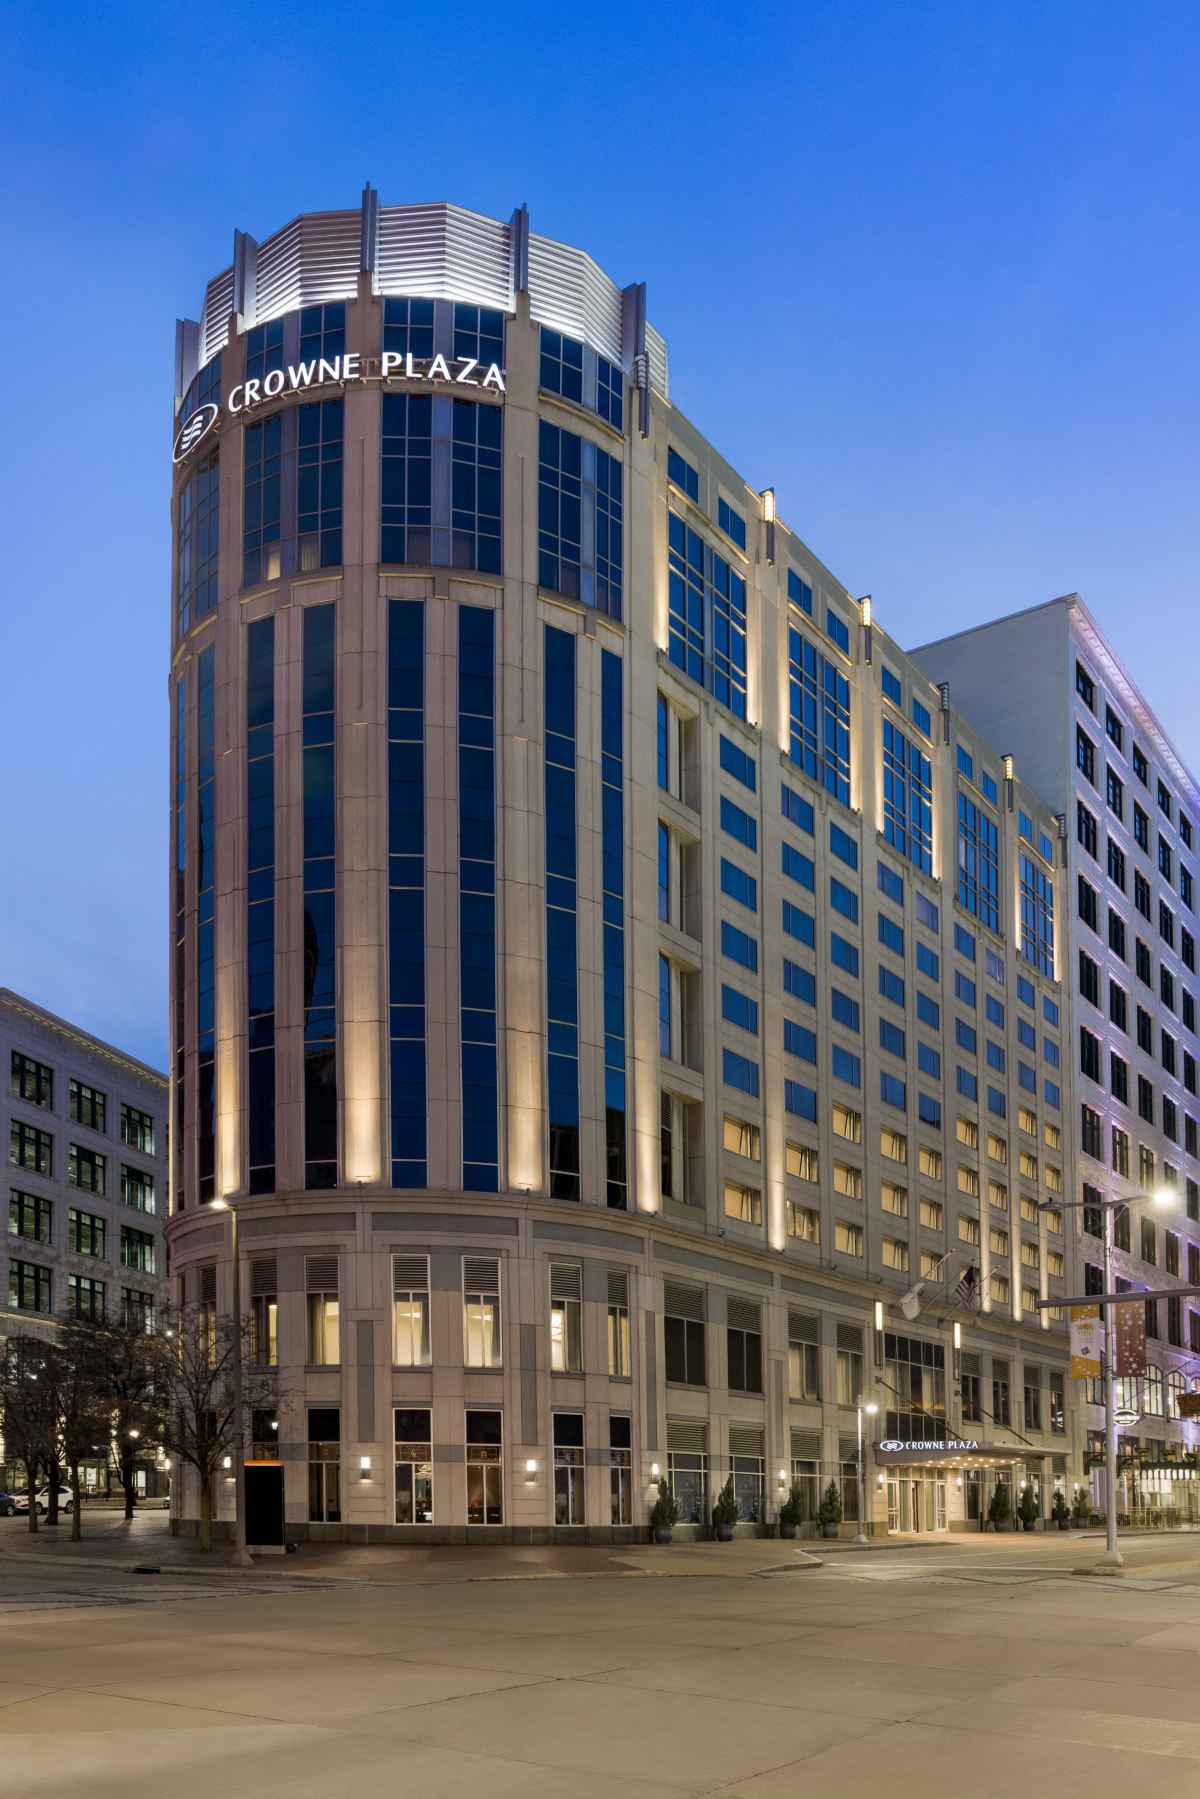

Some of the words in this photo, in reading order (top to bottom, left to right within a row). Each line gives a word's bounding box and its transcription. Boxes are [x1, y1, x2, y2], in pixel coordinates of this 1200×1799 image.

[228, 353, 361, 413] CROWNE
[381, 351, 506, 391] PLAZA
[905, 1441, 945, 1450] CROWNE
[948, 1440, 979, 1449] PLAZA
